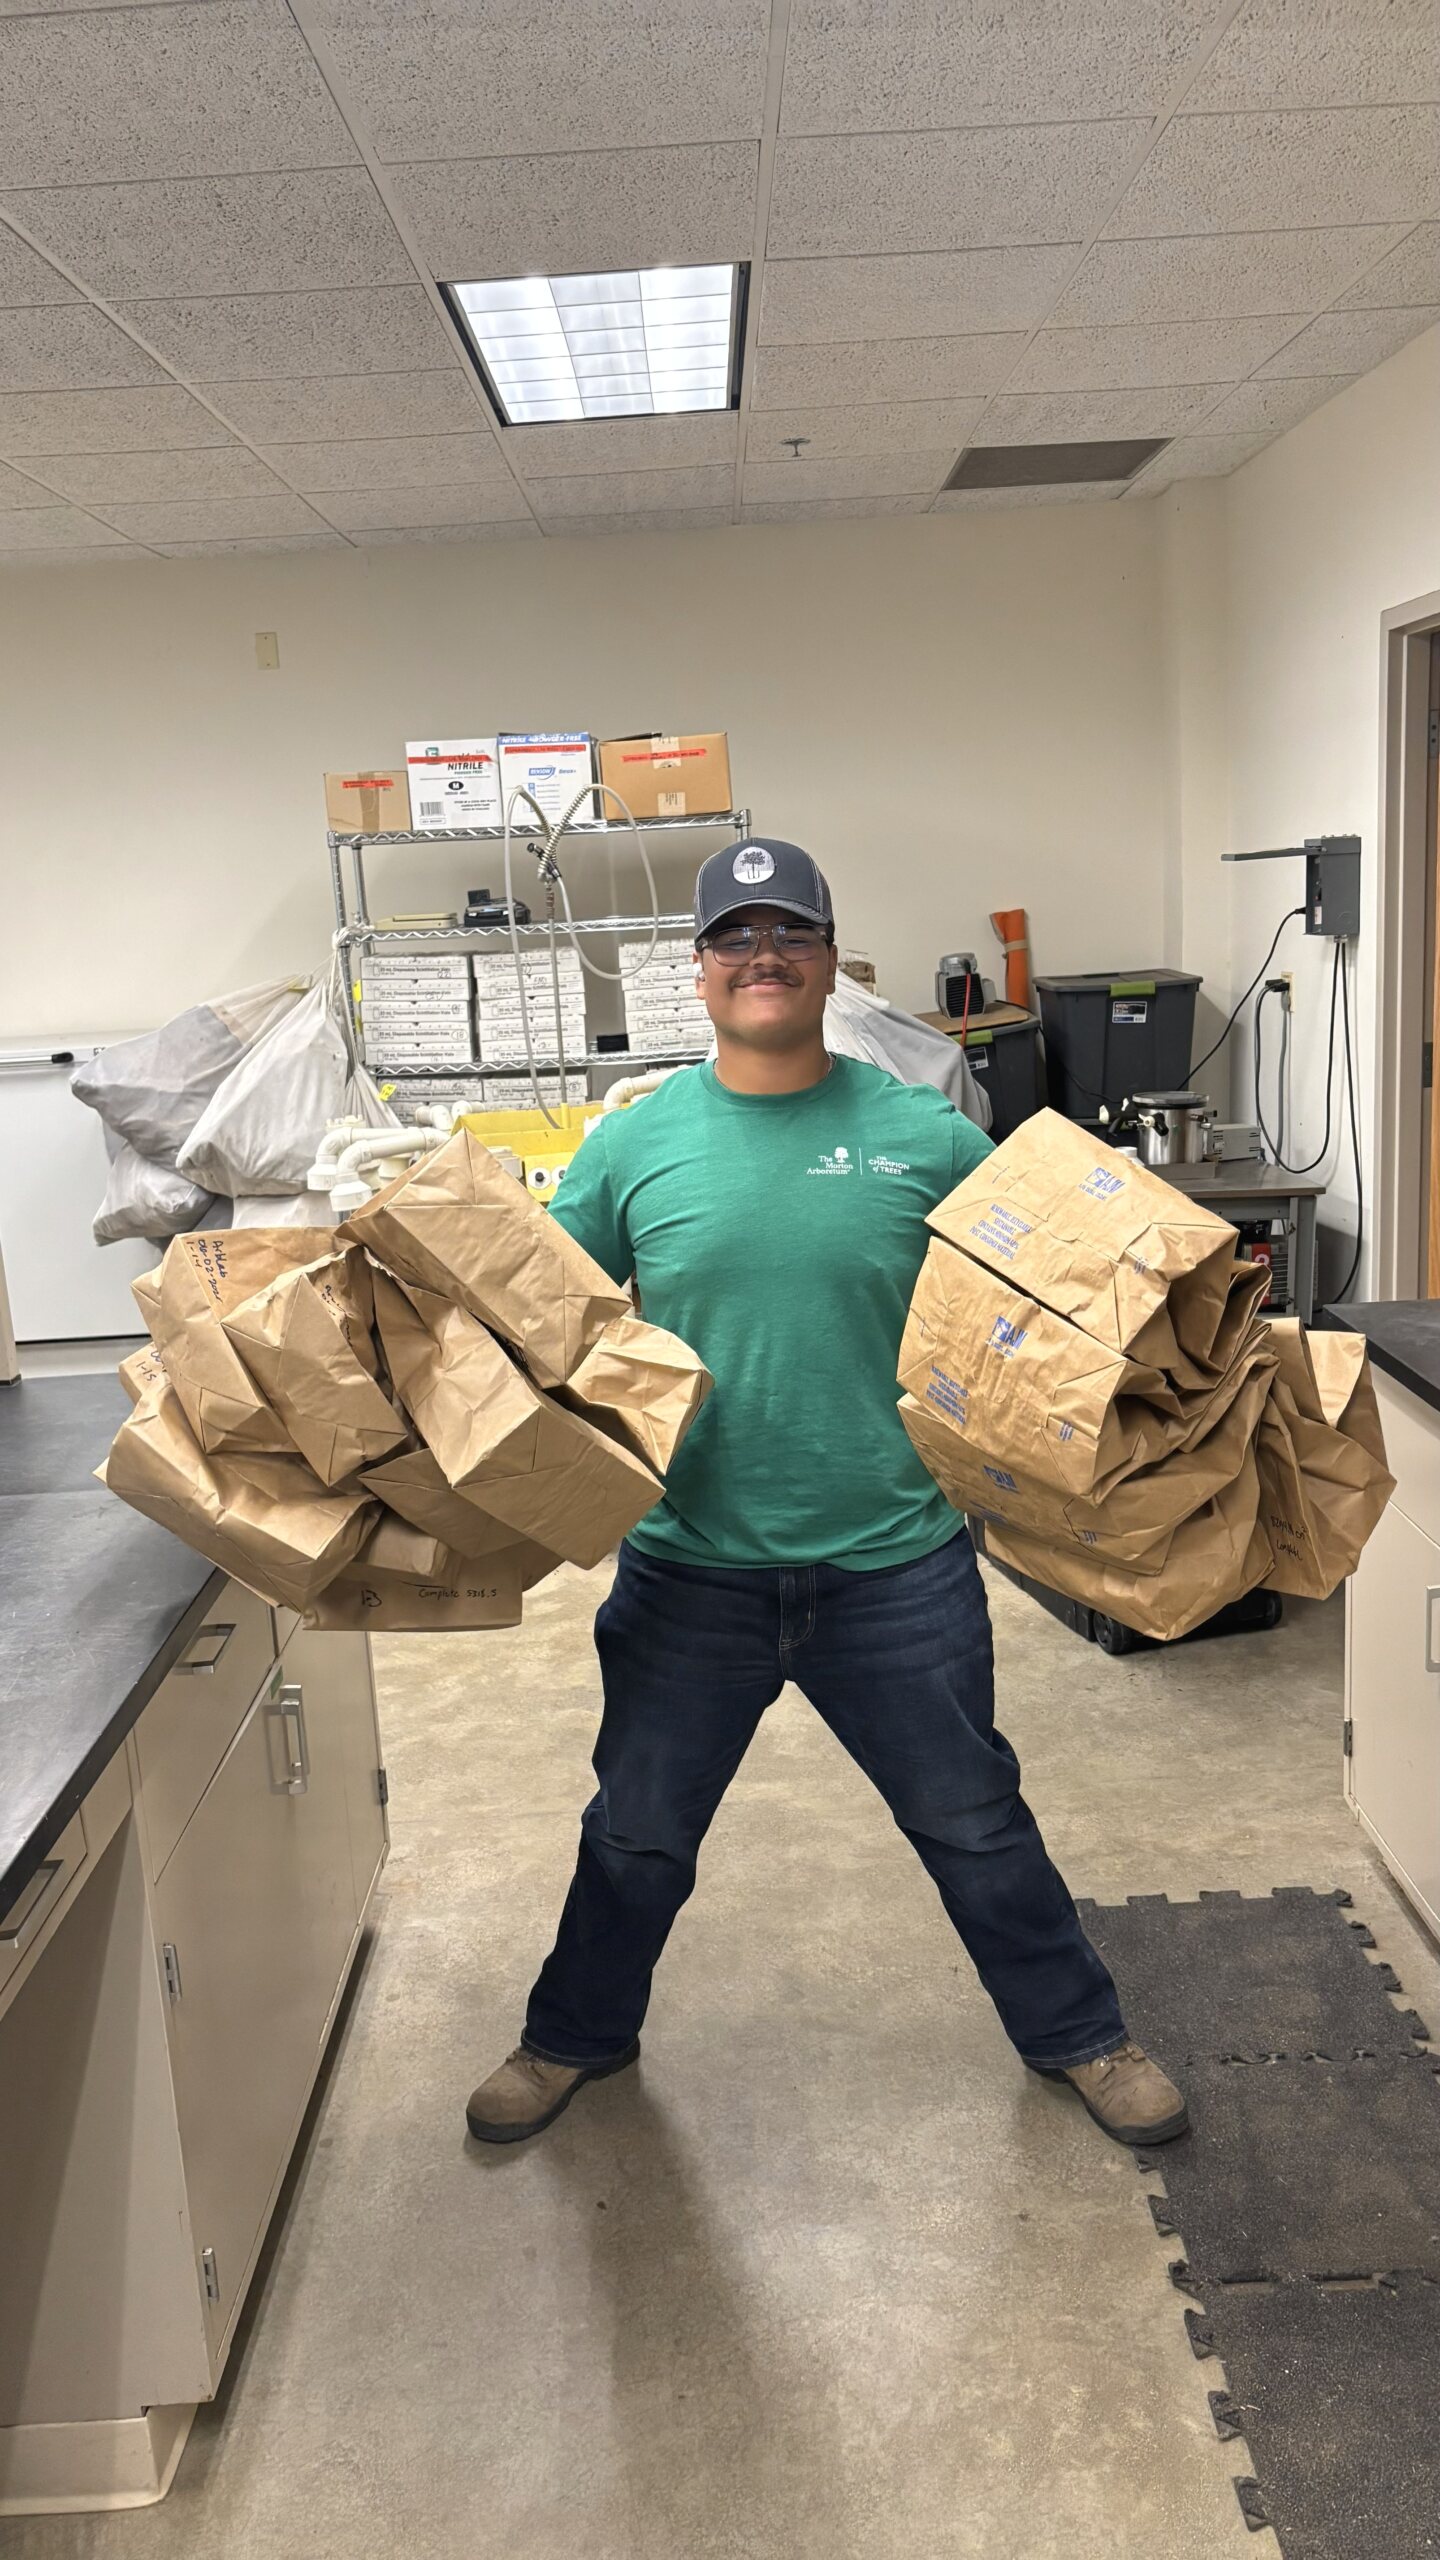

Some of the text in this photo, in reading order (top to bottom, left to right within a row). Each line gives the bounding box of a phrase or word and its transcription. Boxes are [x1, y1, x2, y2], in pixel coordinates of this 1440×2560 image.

[448, 762, 484, 770] NITRILE
[868, 1159, 910, 1170] CHAMPION
[880, 1166, 902, 1175] TREES
